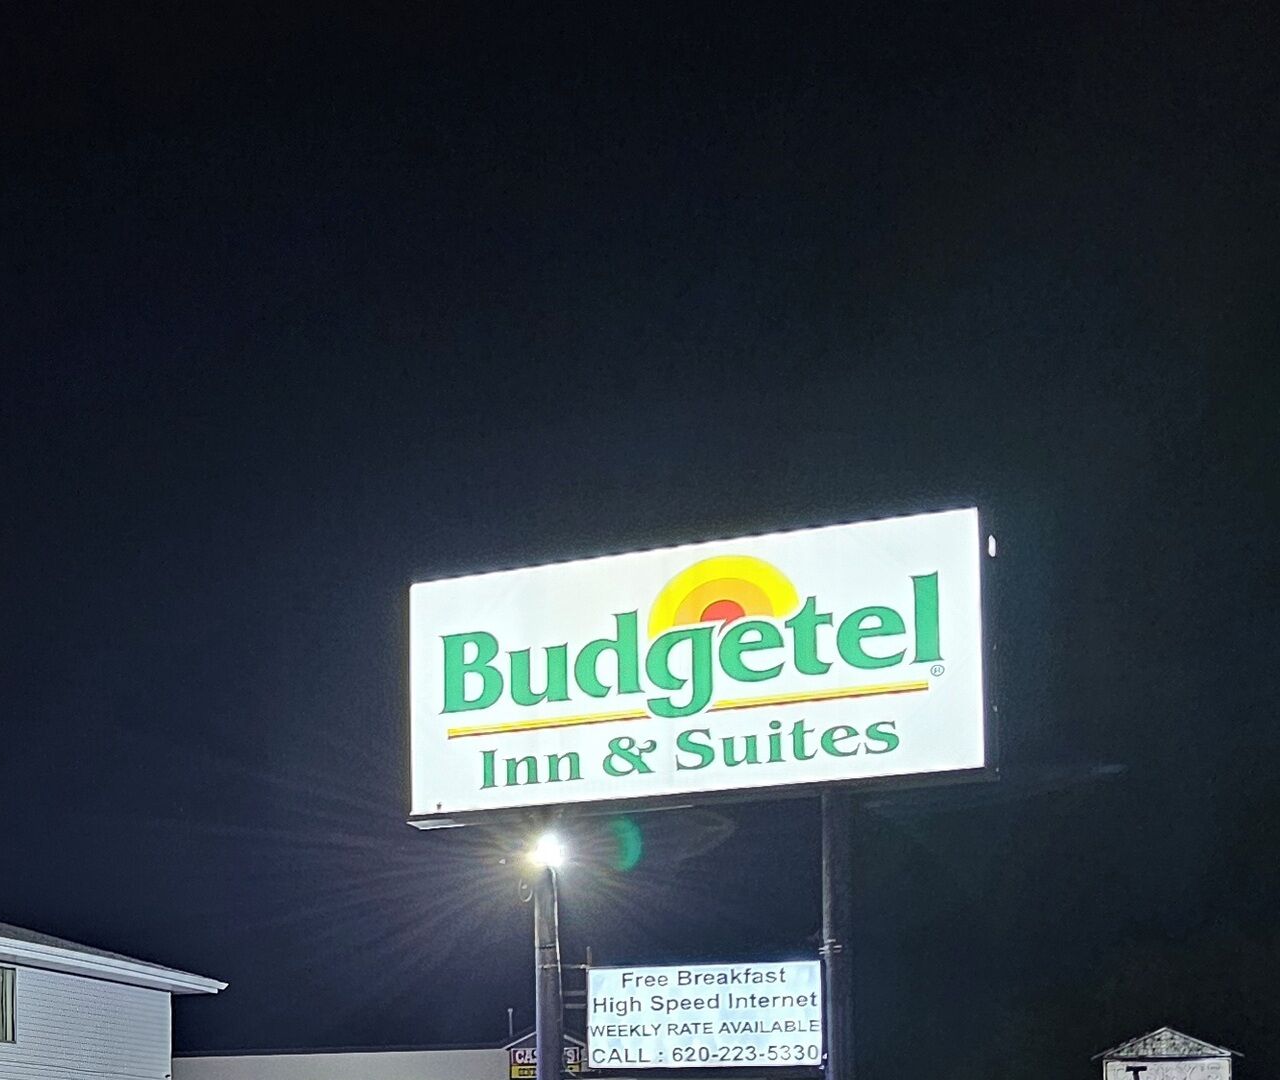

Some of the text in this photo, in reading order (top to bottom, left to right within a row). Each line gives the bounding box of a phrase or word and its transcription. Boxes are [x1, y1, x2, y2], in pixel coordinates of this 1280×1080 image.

[438, 570, 944, 718] Budgetel
[479, 719, 900, 790] Inn & Suites
[622, 967, 786, 988] Free Breakfast
[593, 992, 818, 1016] High Speed Internet
[589, 1020, 820, 1037] WEEKLY RATE AVAILABLE
[592, 1048, 651, 1063] CALL
[672, 1044, 819, 1062] 620-223-5330
